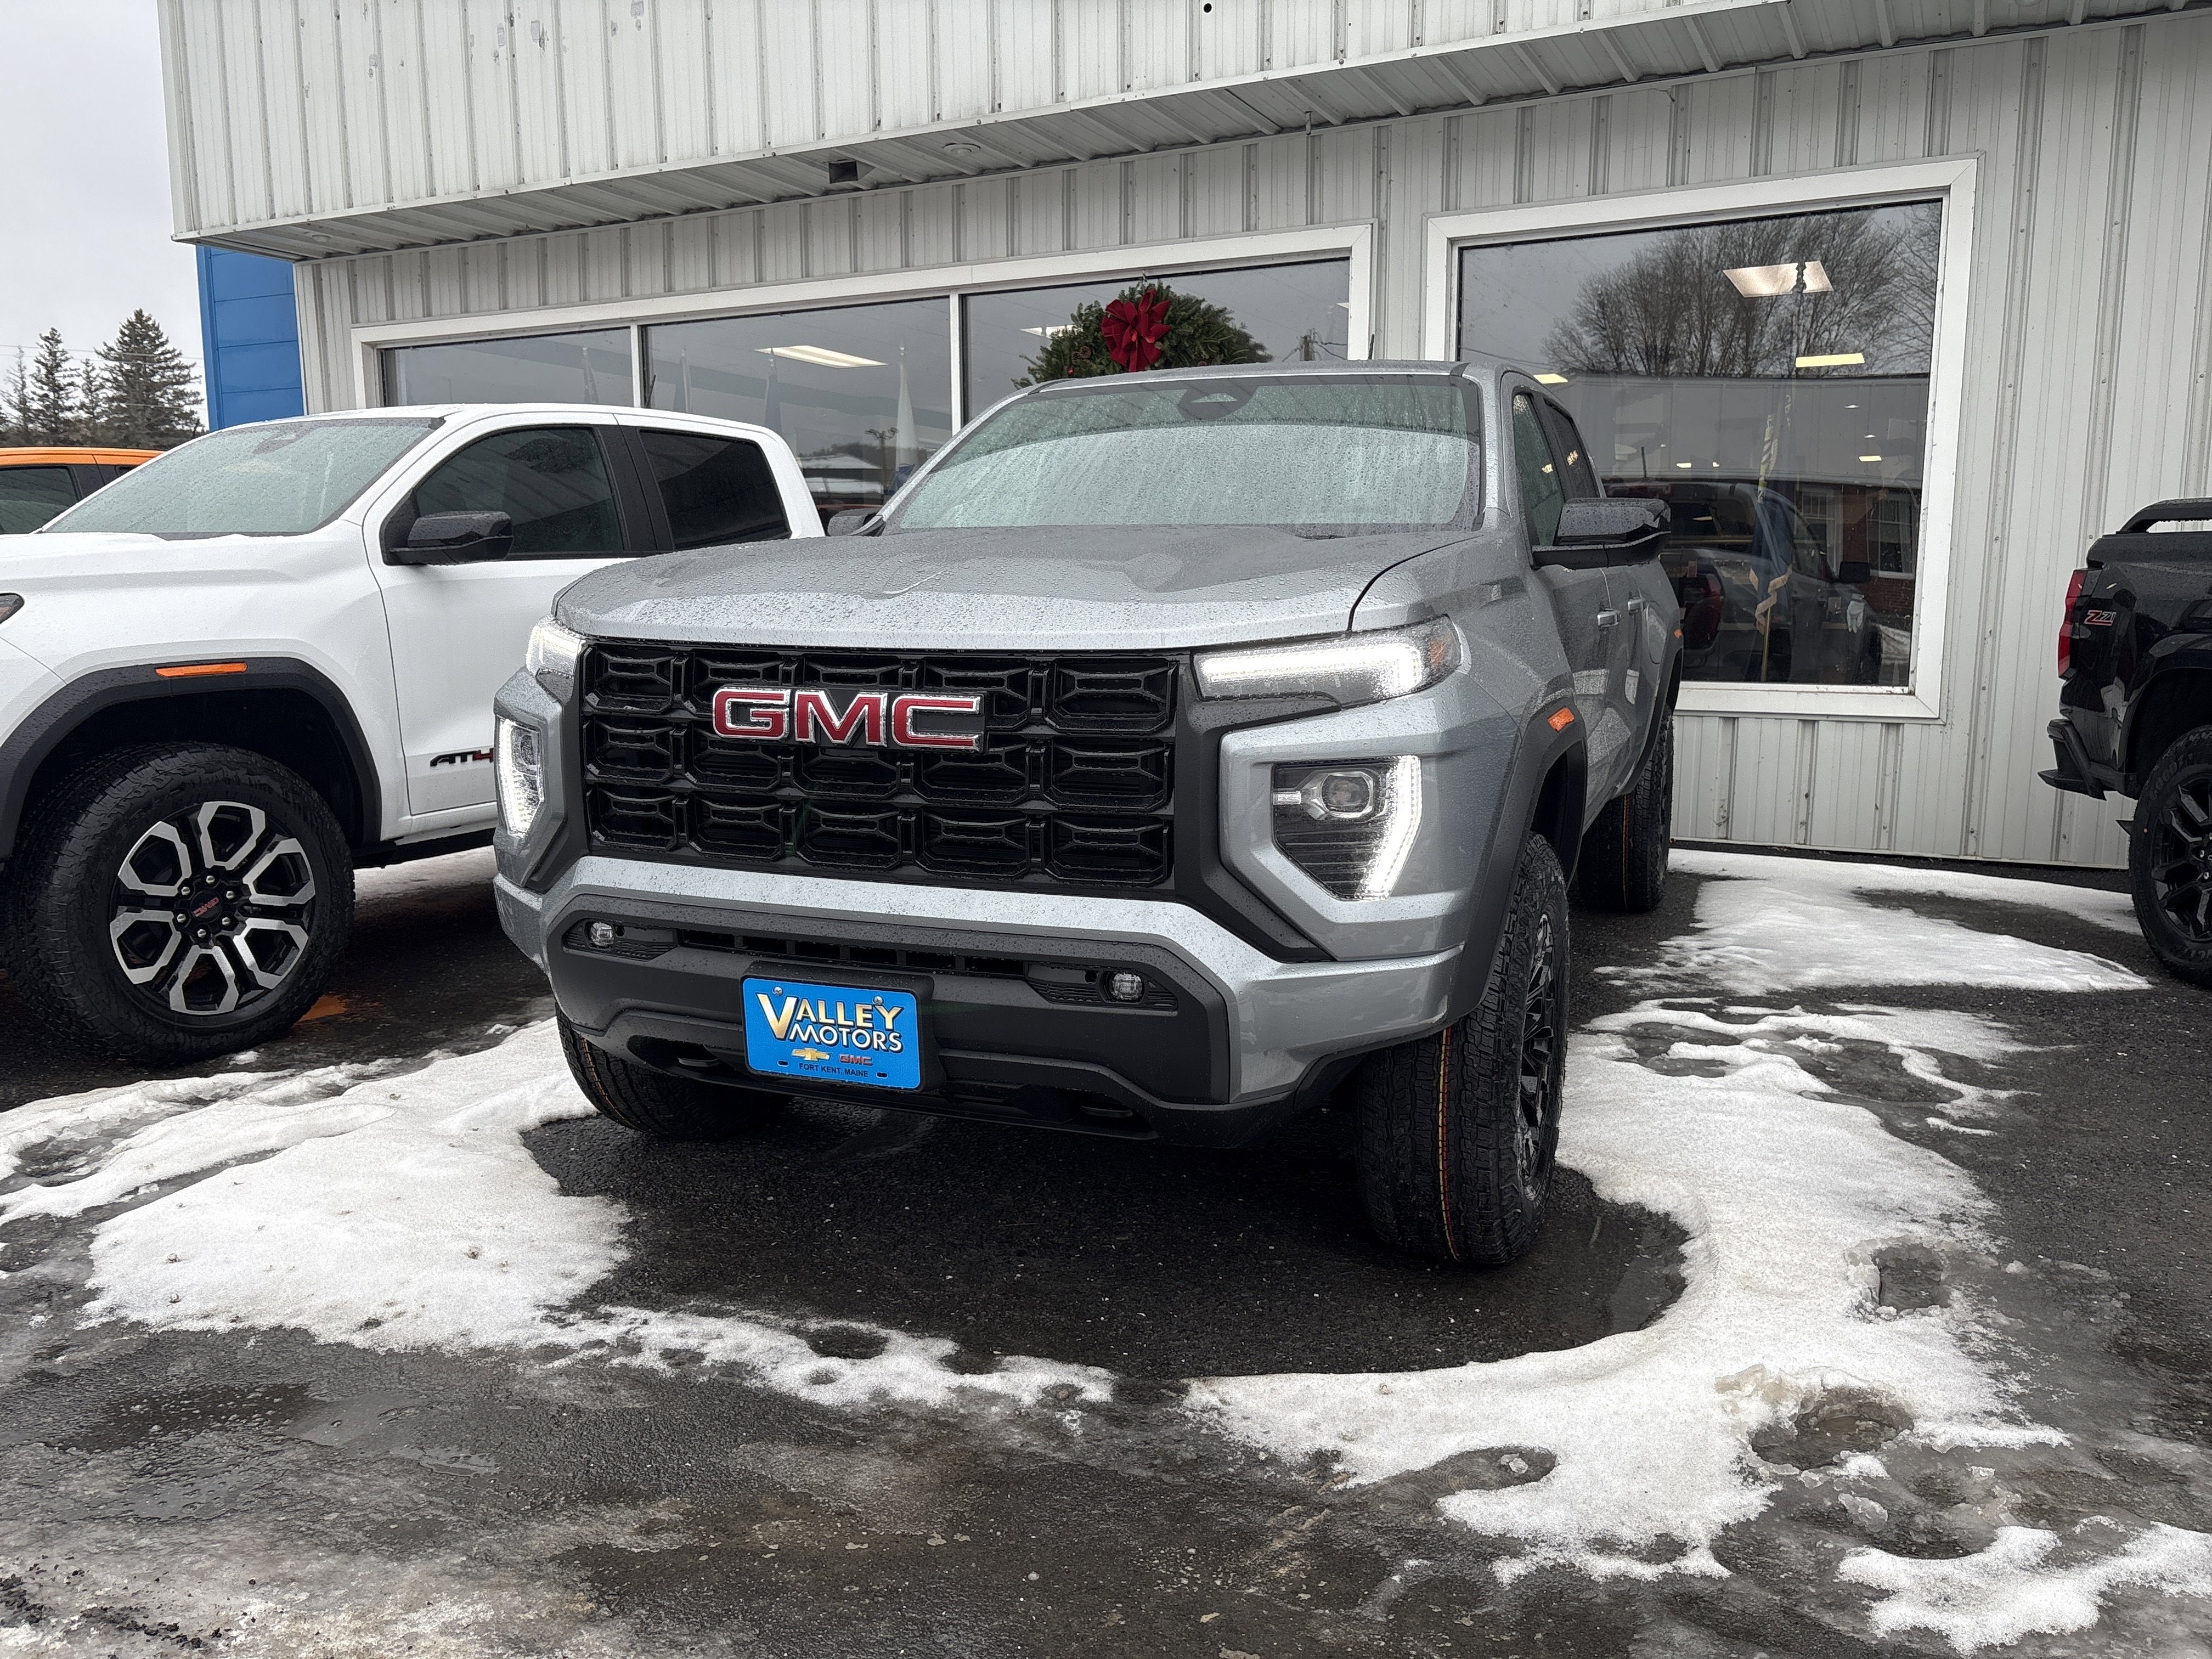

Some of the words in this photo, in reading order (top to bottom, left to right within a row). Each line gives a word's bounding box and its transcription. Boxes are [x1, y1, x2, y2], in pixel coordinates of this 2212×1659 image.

[2084, 610, 2117, 627] Z71
[713, 686, 983, 752] GMC
[756, 992, 905, 1040] VALLEY
[789, 1023, 903, 1053] MOTORS
[799, 1063, 819, 1071] FORT
[821, 1065, 843, 1075] KENT,
[845, 1068, 869, 1077] MAINE
[839, 1053, 873, 1066] GMC
